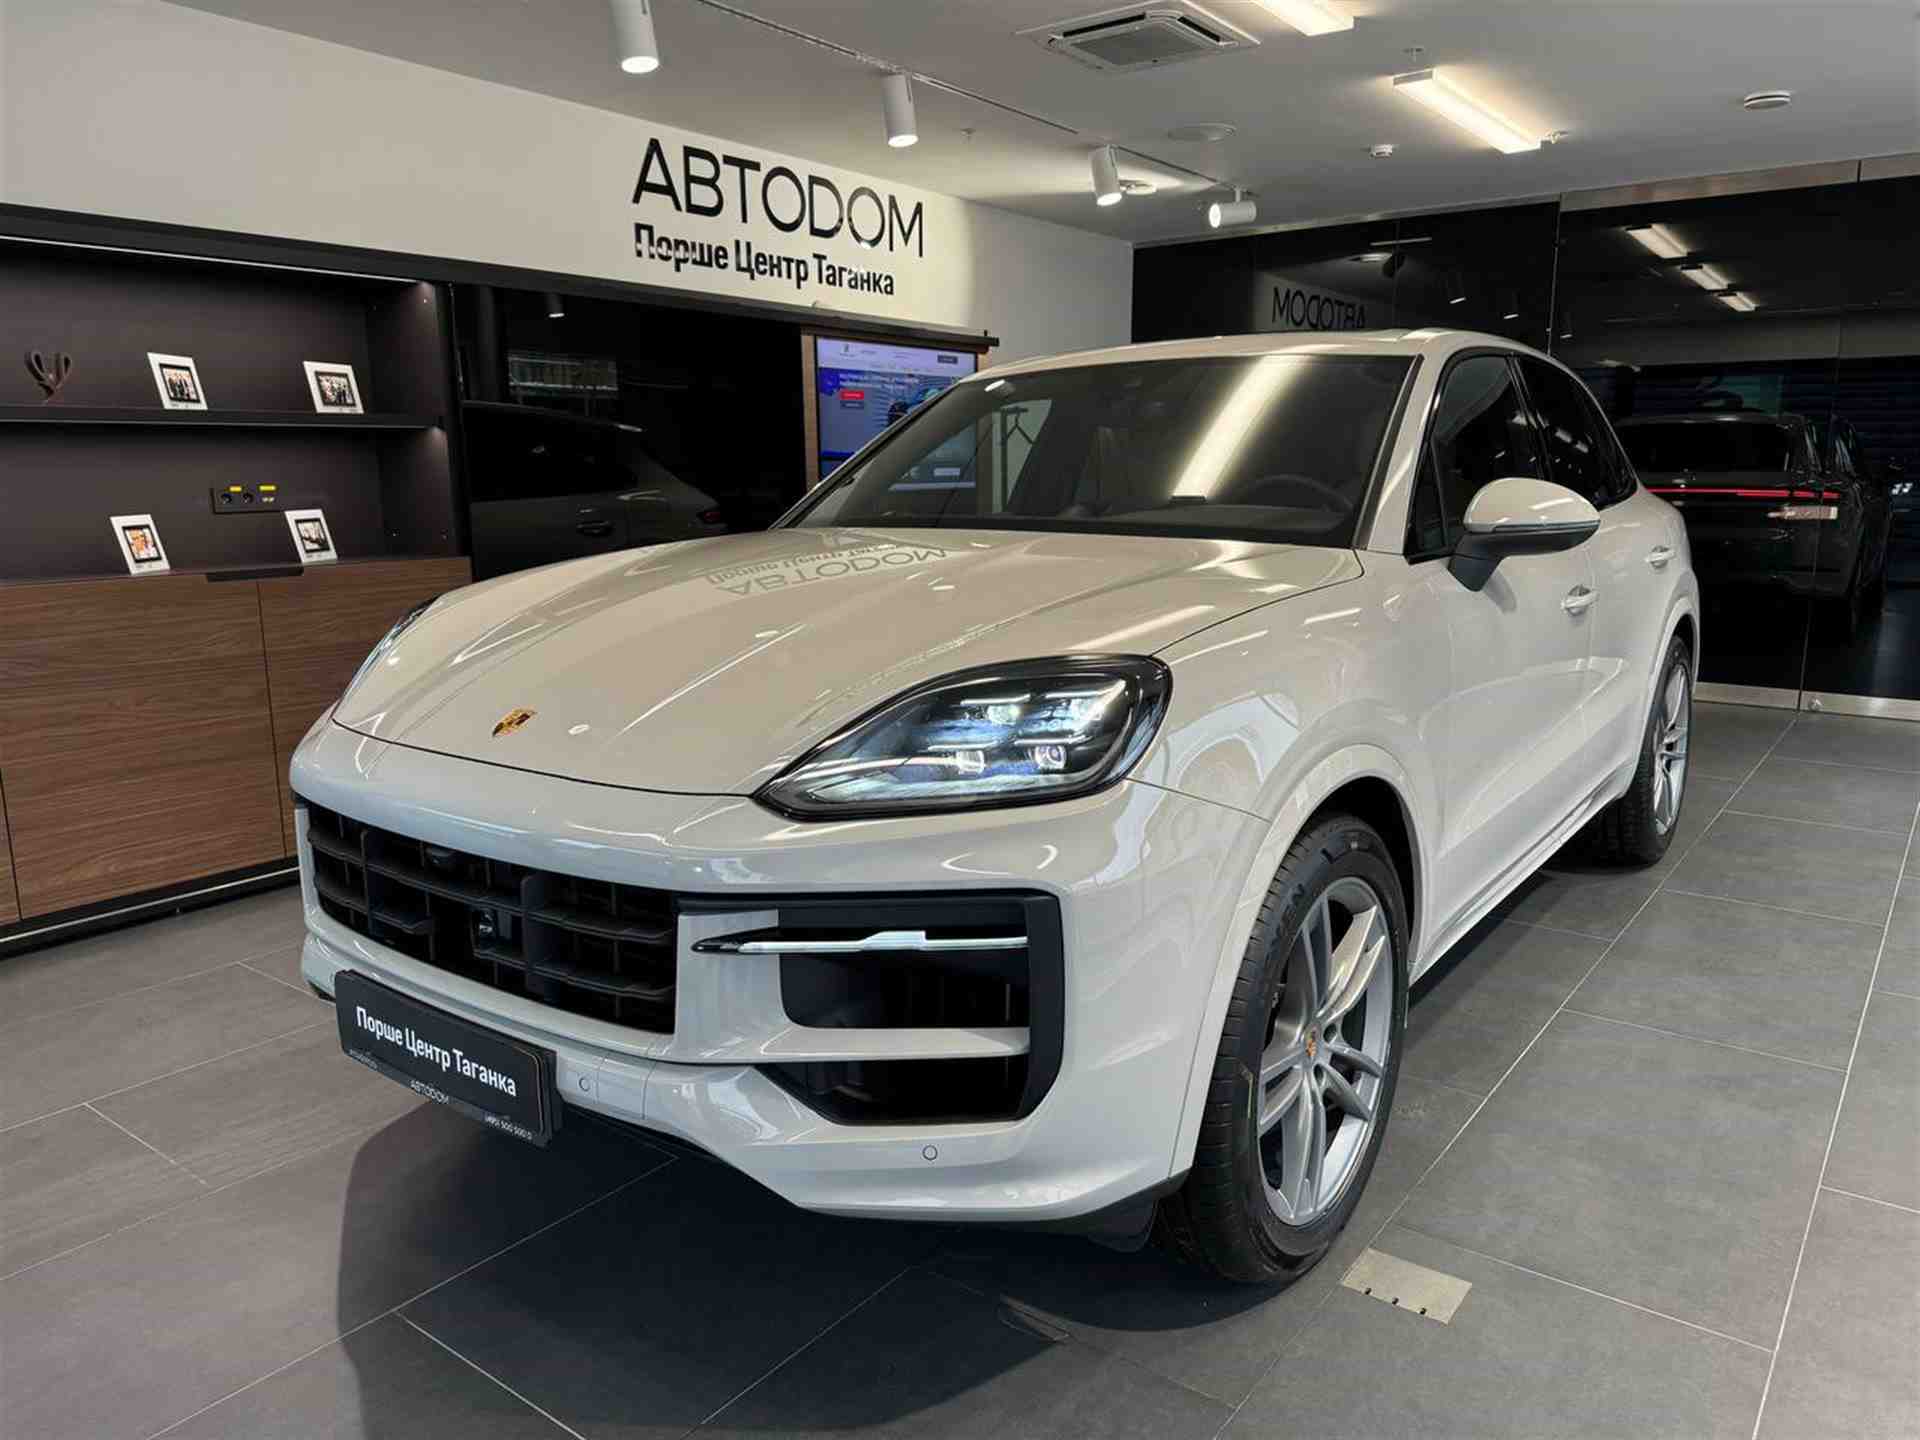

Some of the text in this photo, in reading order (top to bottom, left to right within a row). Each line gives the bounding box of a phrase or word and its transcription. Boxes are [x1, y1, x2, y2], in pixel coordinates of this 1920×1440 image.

[634, 222, 895, 296] Порше Центр Таганка
[356, 1006, 403, 1046] Порше
[405, 1028, 450, 1072] Центр
[452, 1049, 517, 1097] Таганка
